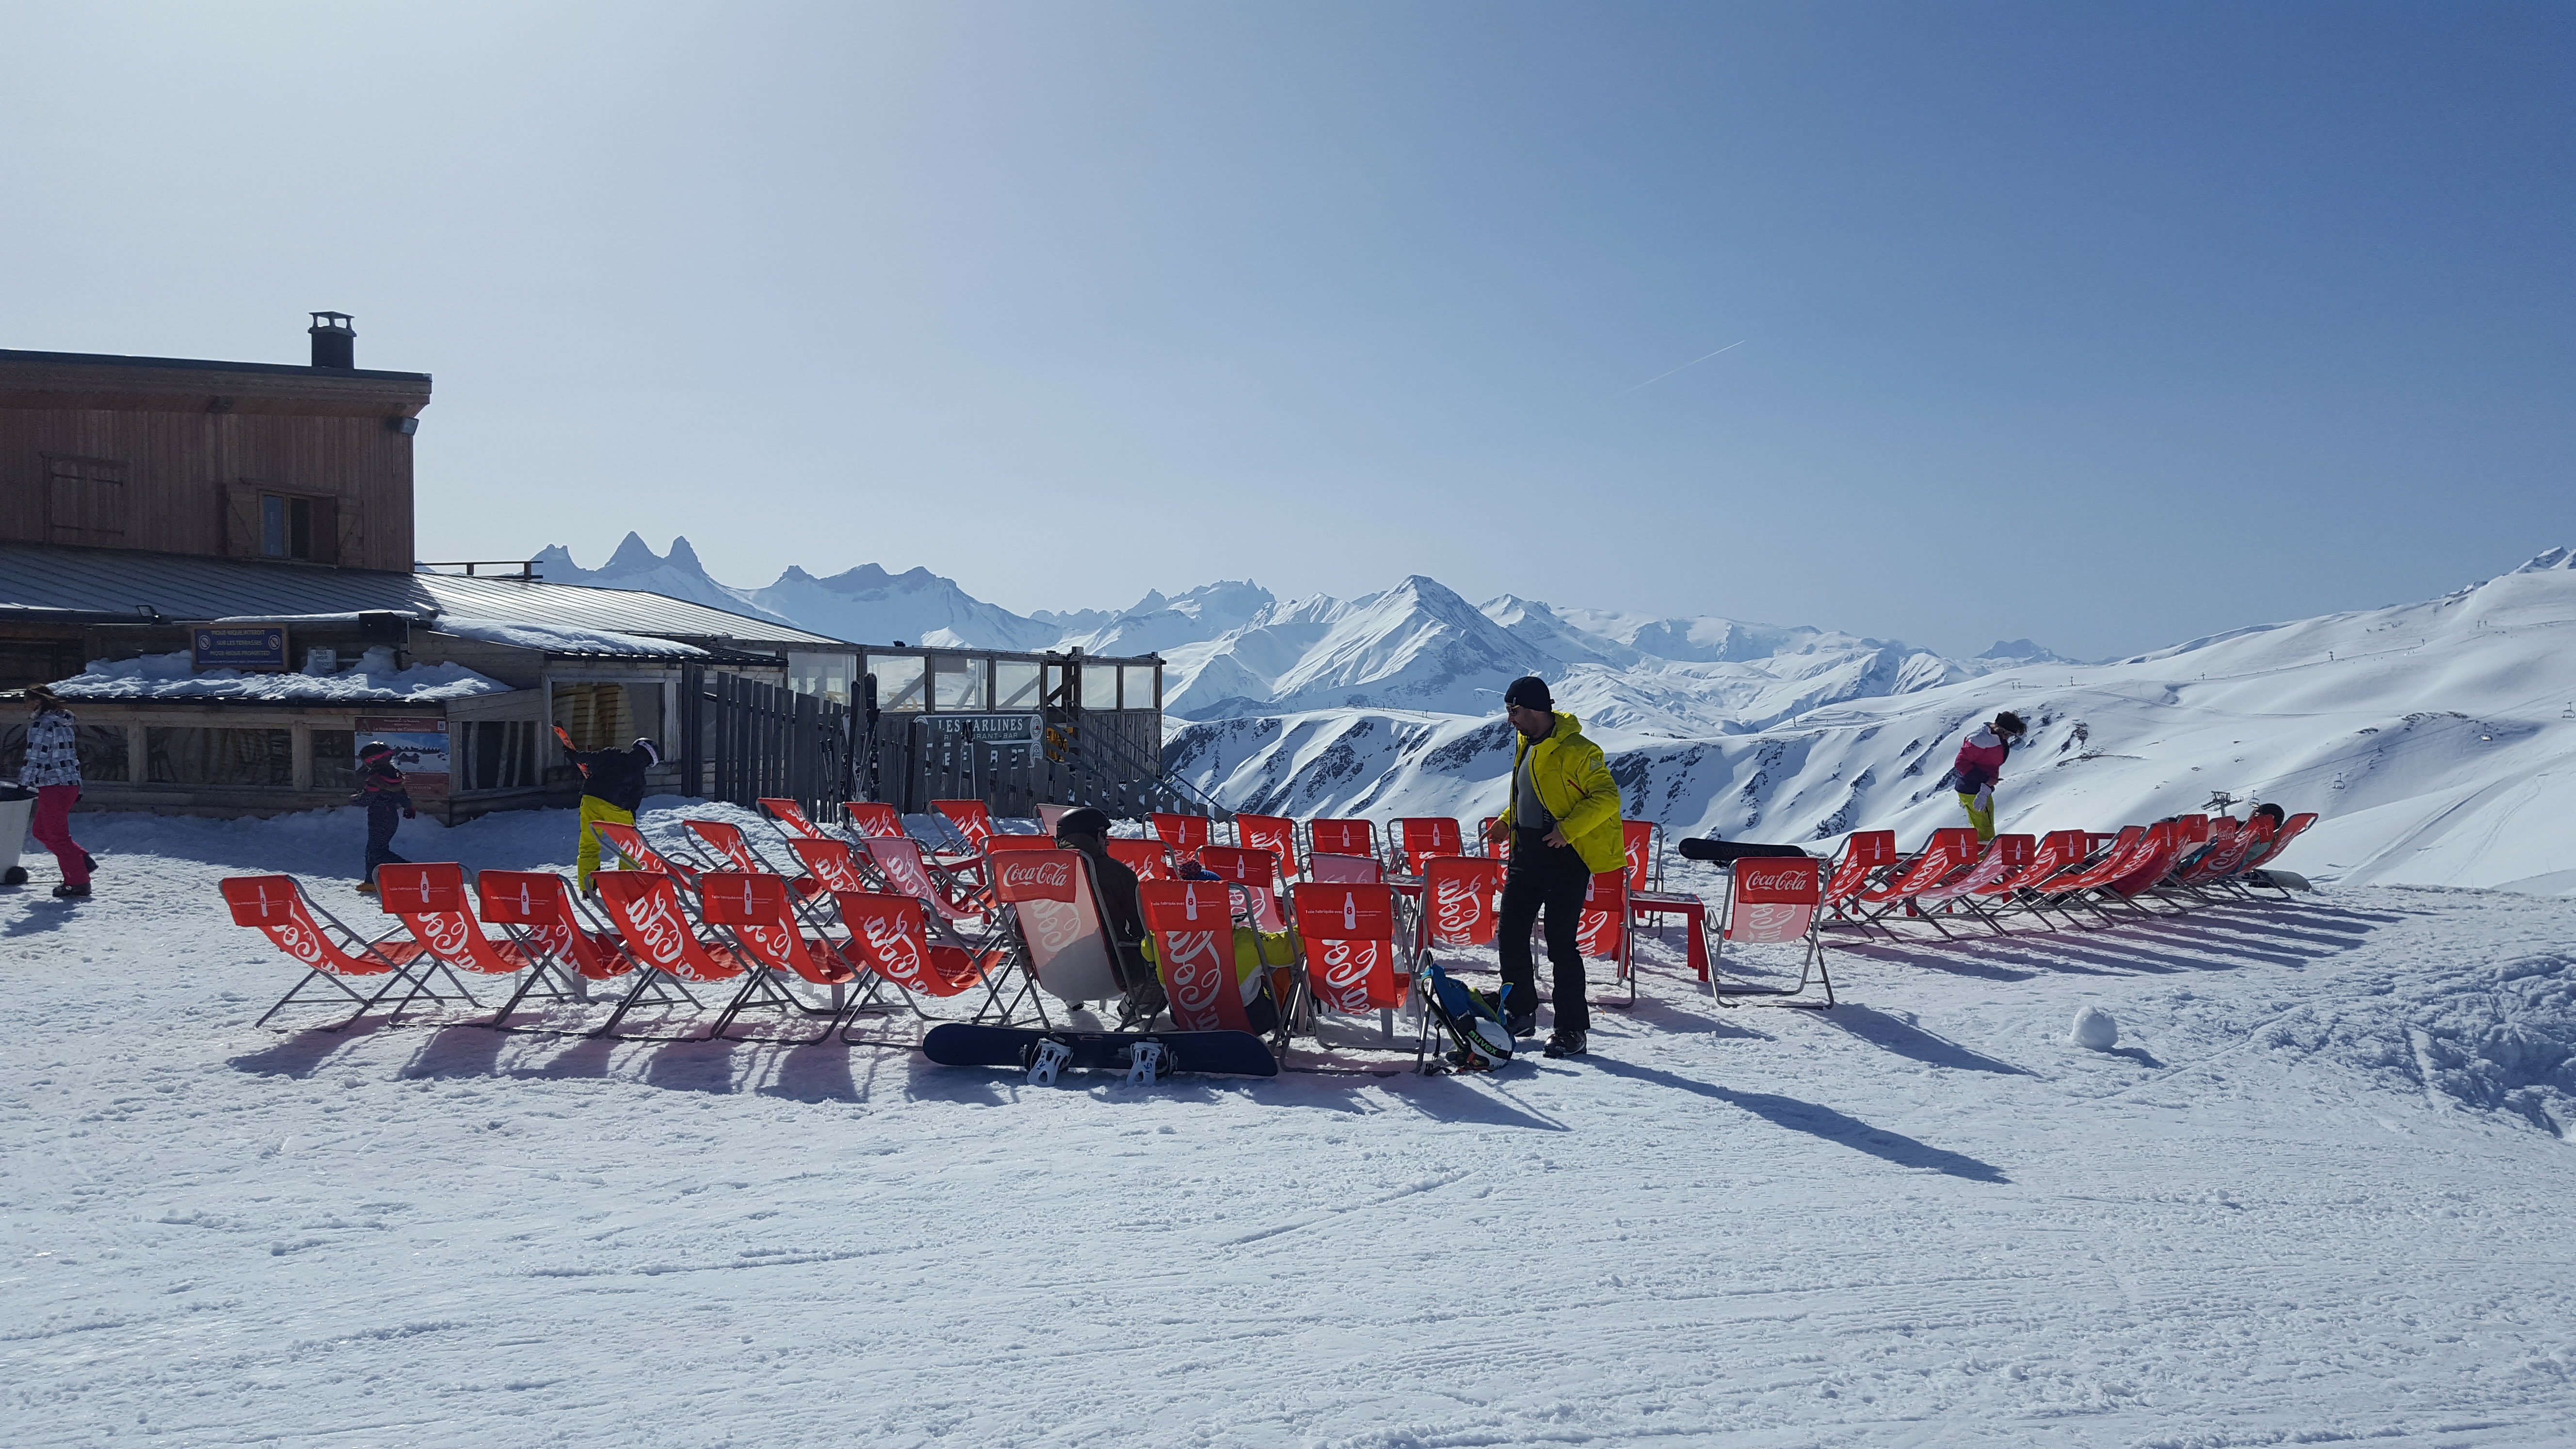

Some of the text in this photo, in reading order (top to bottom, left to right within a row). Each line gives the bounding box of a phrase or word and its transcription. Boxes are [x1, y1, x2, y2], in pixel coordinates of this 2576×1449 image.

[965, 719, 1023, 731] ARLINES
[1003, 862, 1070, 887] Coca-Cola
[1746, 870, 1810, 891] Coca-Cola
[1474, 1036, 1497, 1055] uvex
